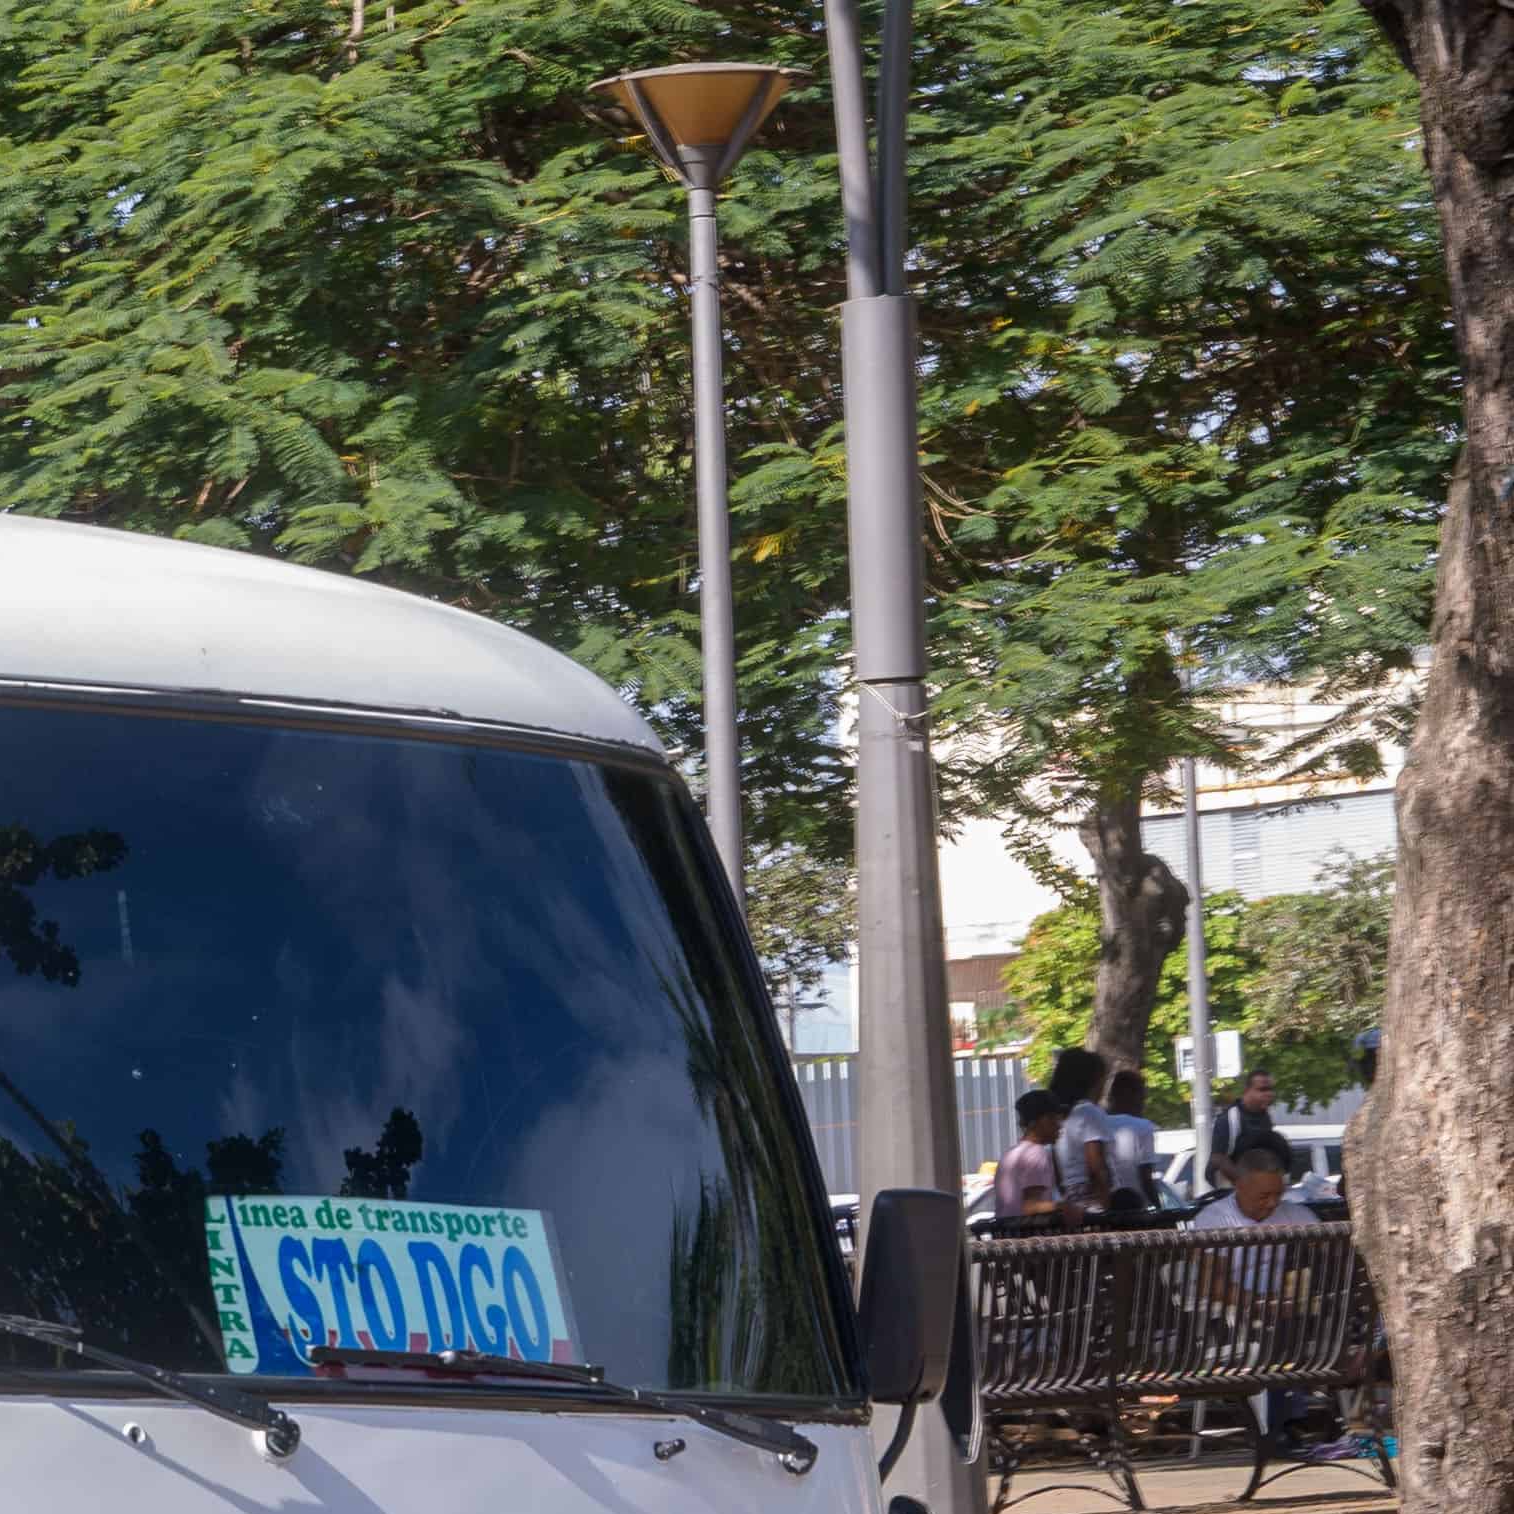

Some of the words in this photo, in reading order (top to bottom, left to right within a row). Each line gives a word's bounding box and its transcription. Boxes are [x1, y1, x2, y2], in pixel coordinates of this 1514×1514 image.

[205, 1197, 256, 1360] LINTRA
[315, 1198, 353, 1231] de
[358, 1203, 529, 1243] transporte
[278, 1235, 407, 1364] STO
[407, 1240, 551, 1364] DGO
